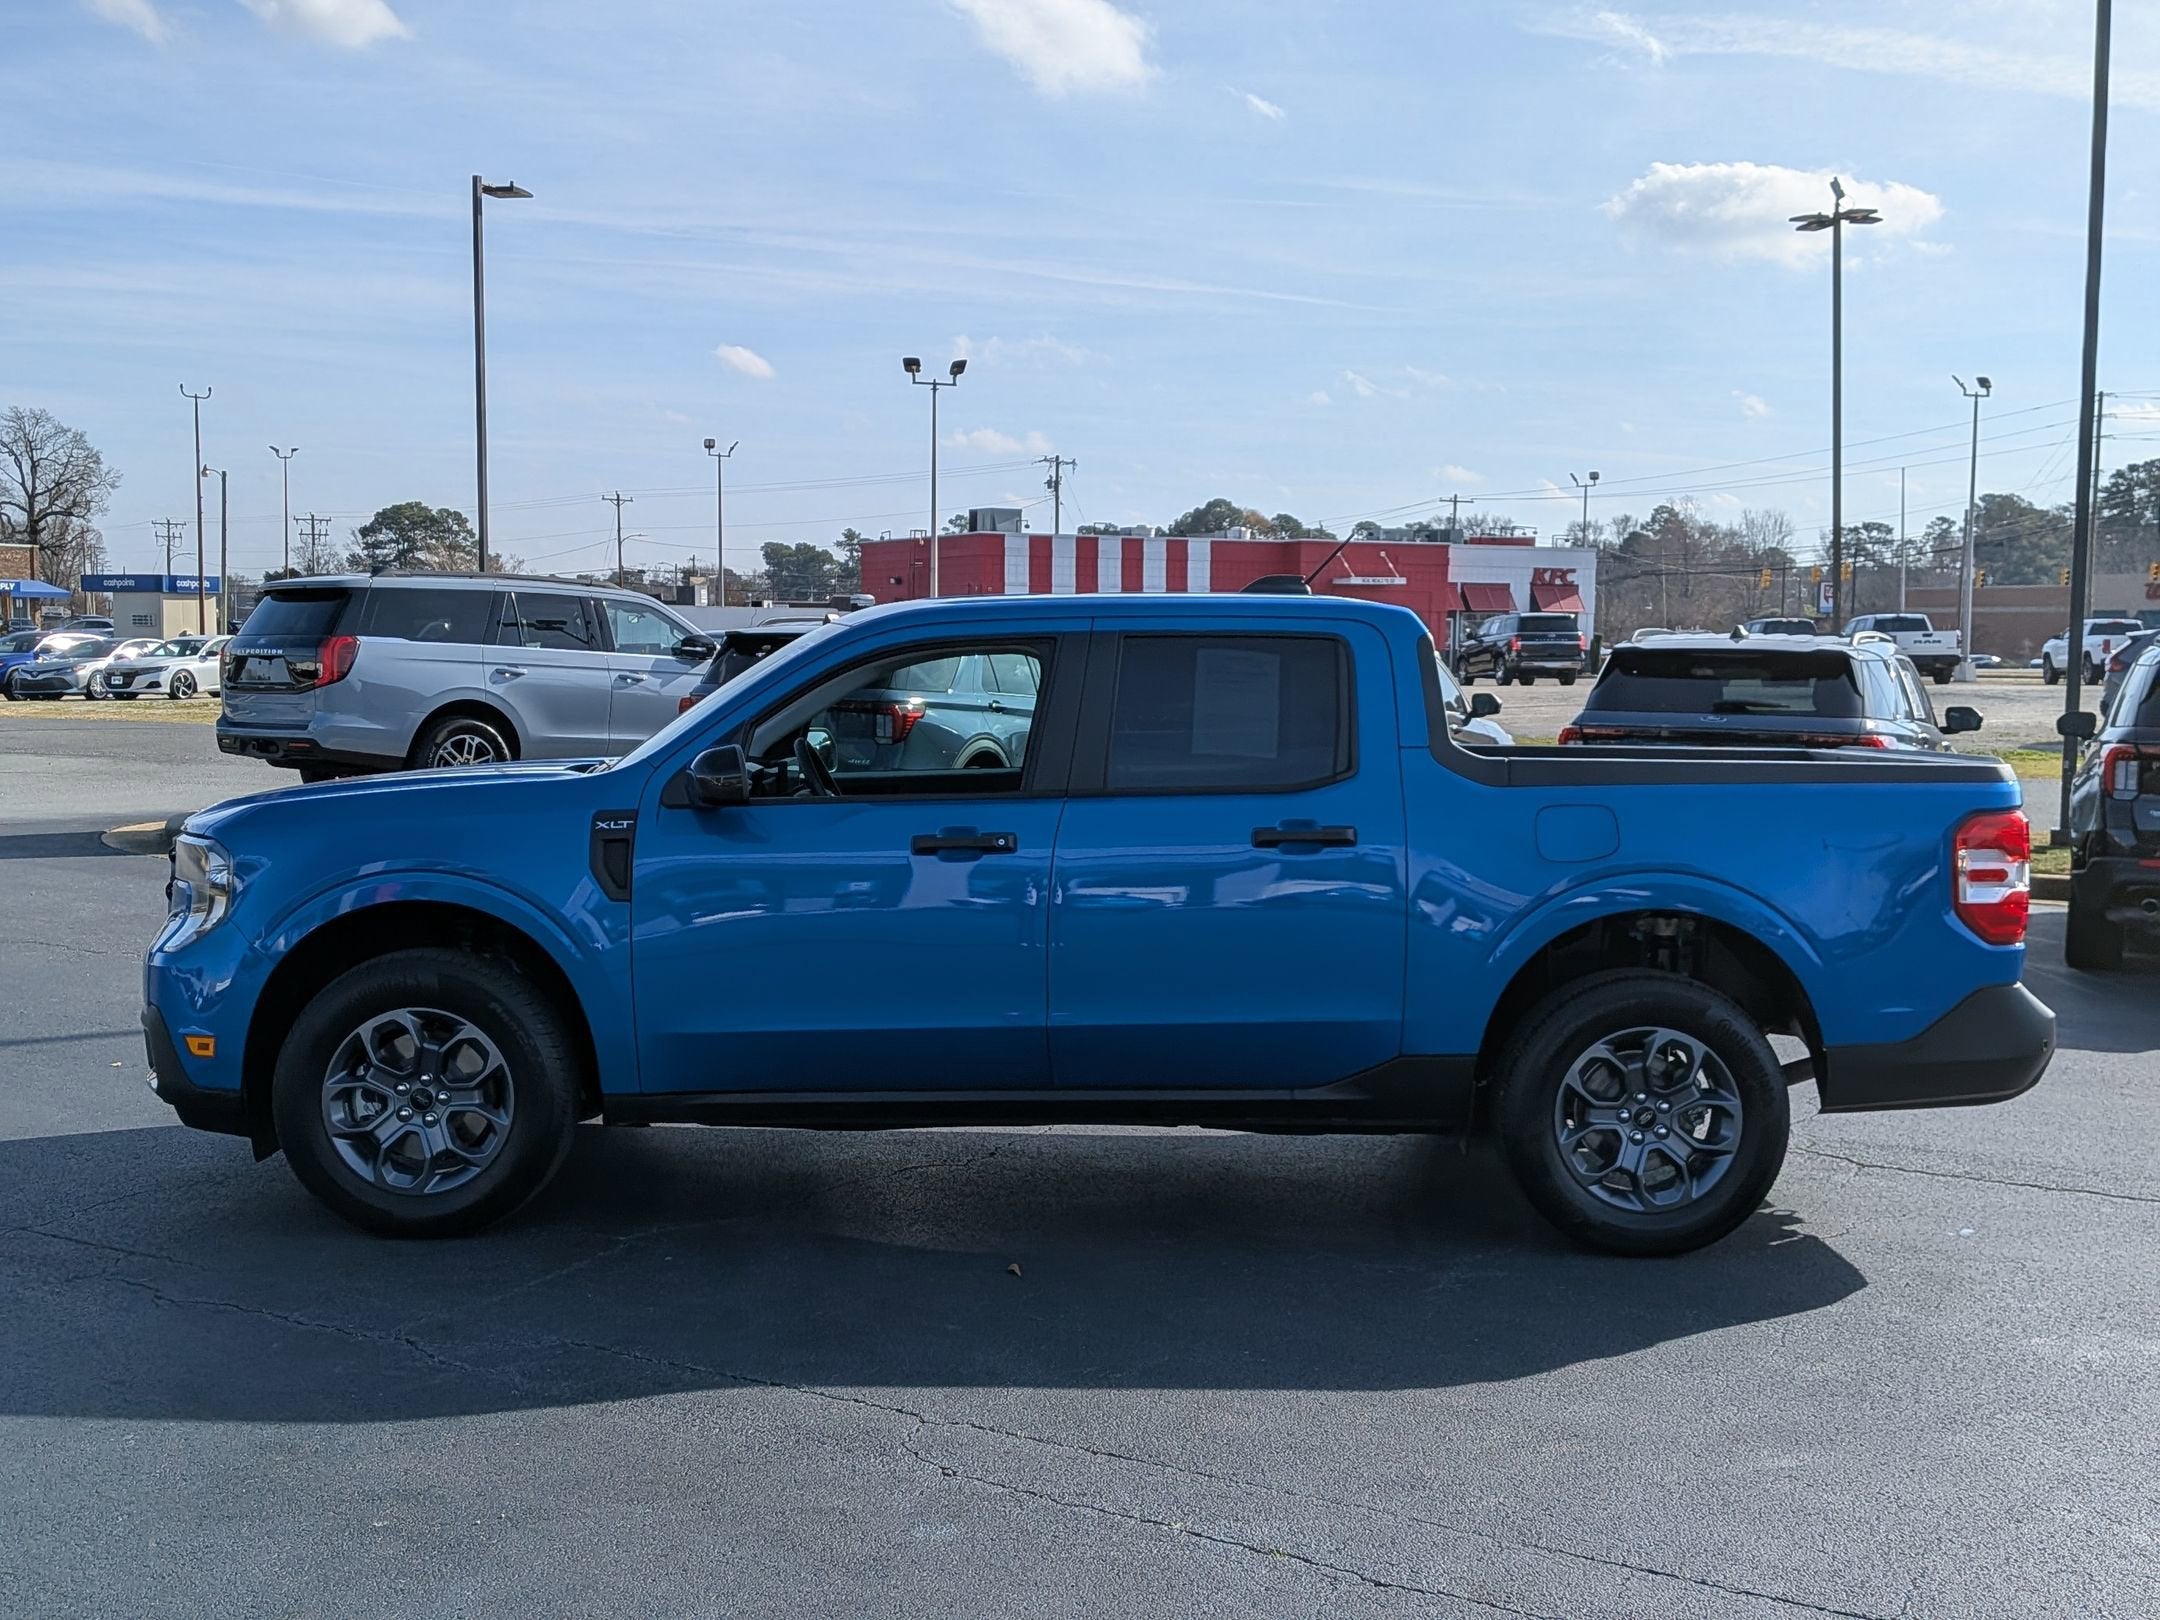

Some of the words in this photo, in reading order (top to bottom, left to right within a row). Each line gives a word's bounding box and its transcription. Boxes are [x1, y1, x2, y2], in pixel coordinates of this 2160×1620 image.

[1532, 567, 1577, 585] KFC
[103, 578, 135, 588] cashpoints
[595, 820, 634, 829] XLT
